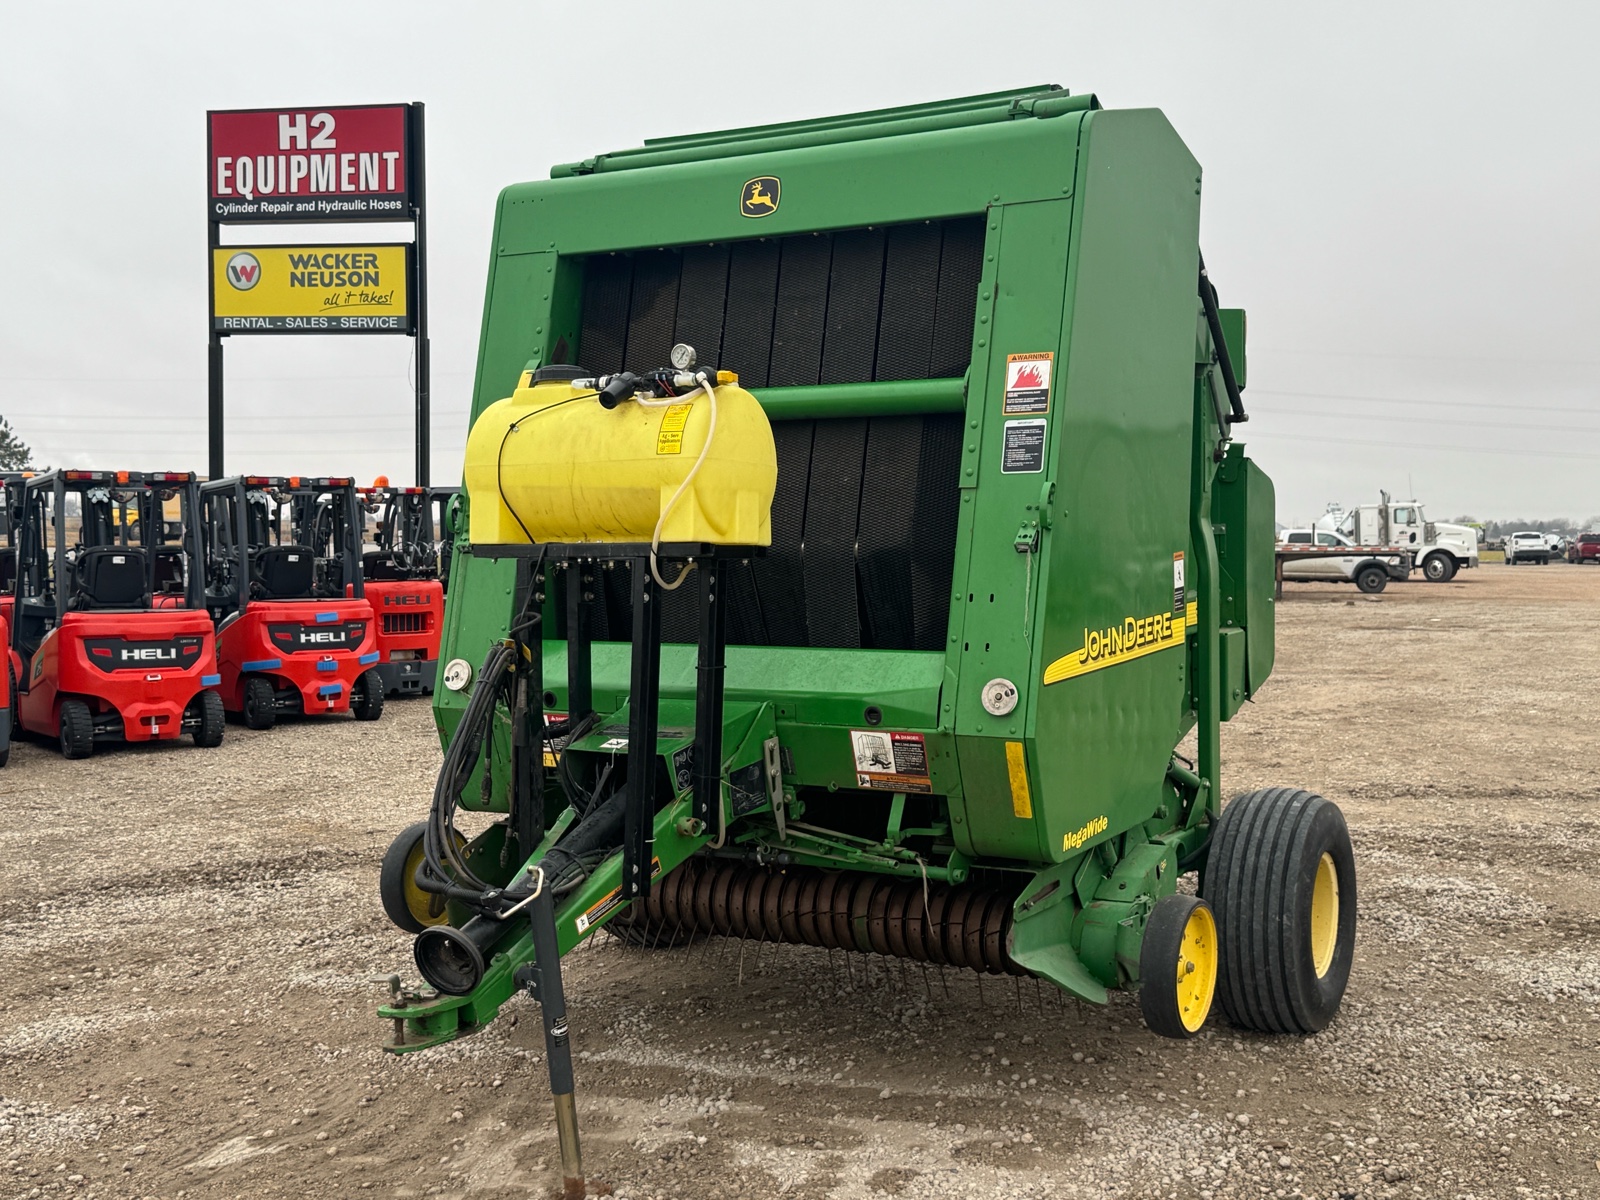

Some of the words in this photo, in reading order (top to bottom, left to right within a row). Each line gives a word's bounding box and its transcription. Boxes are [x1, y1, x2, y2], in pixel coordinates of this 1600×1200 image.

[279, 112, 337, 150] H2
[217, 151, 400, 200] EQUIPMENT
[215, 203, 258, 216] Cylinder
[260, 201, 294, 215] Repair
[296, 200, 314, 212] and
[317, 199, 368, 214] Hydraulic
[369, 199, 402, 211] Hoses
[288, 253, 380, 270] WACKER
[290, 271, 380, 288] NEUSON
[323, 293, 341, 306] all
[344, 290, 357, 304] it
[358, 289, 395, 304] takes!
[223, 317, 275, 329] RENTAL
[285, 317, 328, 329] SALES
[340, 317, 398, 328] SERVICE
[1017, 353, 1049, 361] WARNING
[384, 594, 431, 606] HELI
[300, 632, 346, 643] HELI
[1079, 625, 1122, 664] JOHN
[1124, 611, 1172, 650] DEERE
[121, 648, 177, 660] HELI
[1063, 815, 1108, 852] MegaWide
